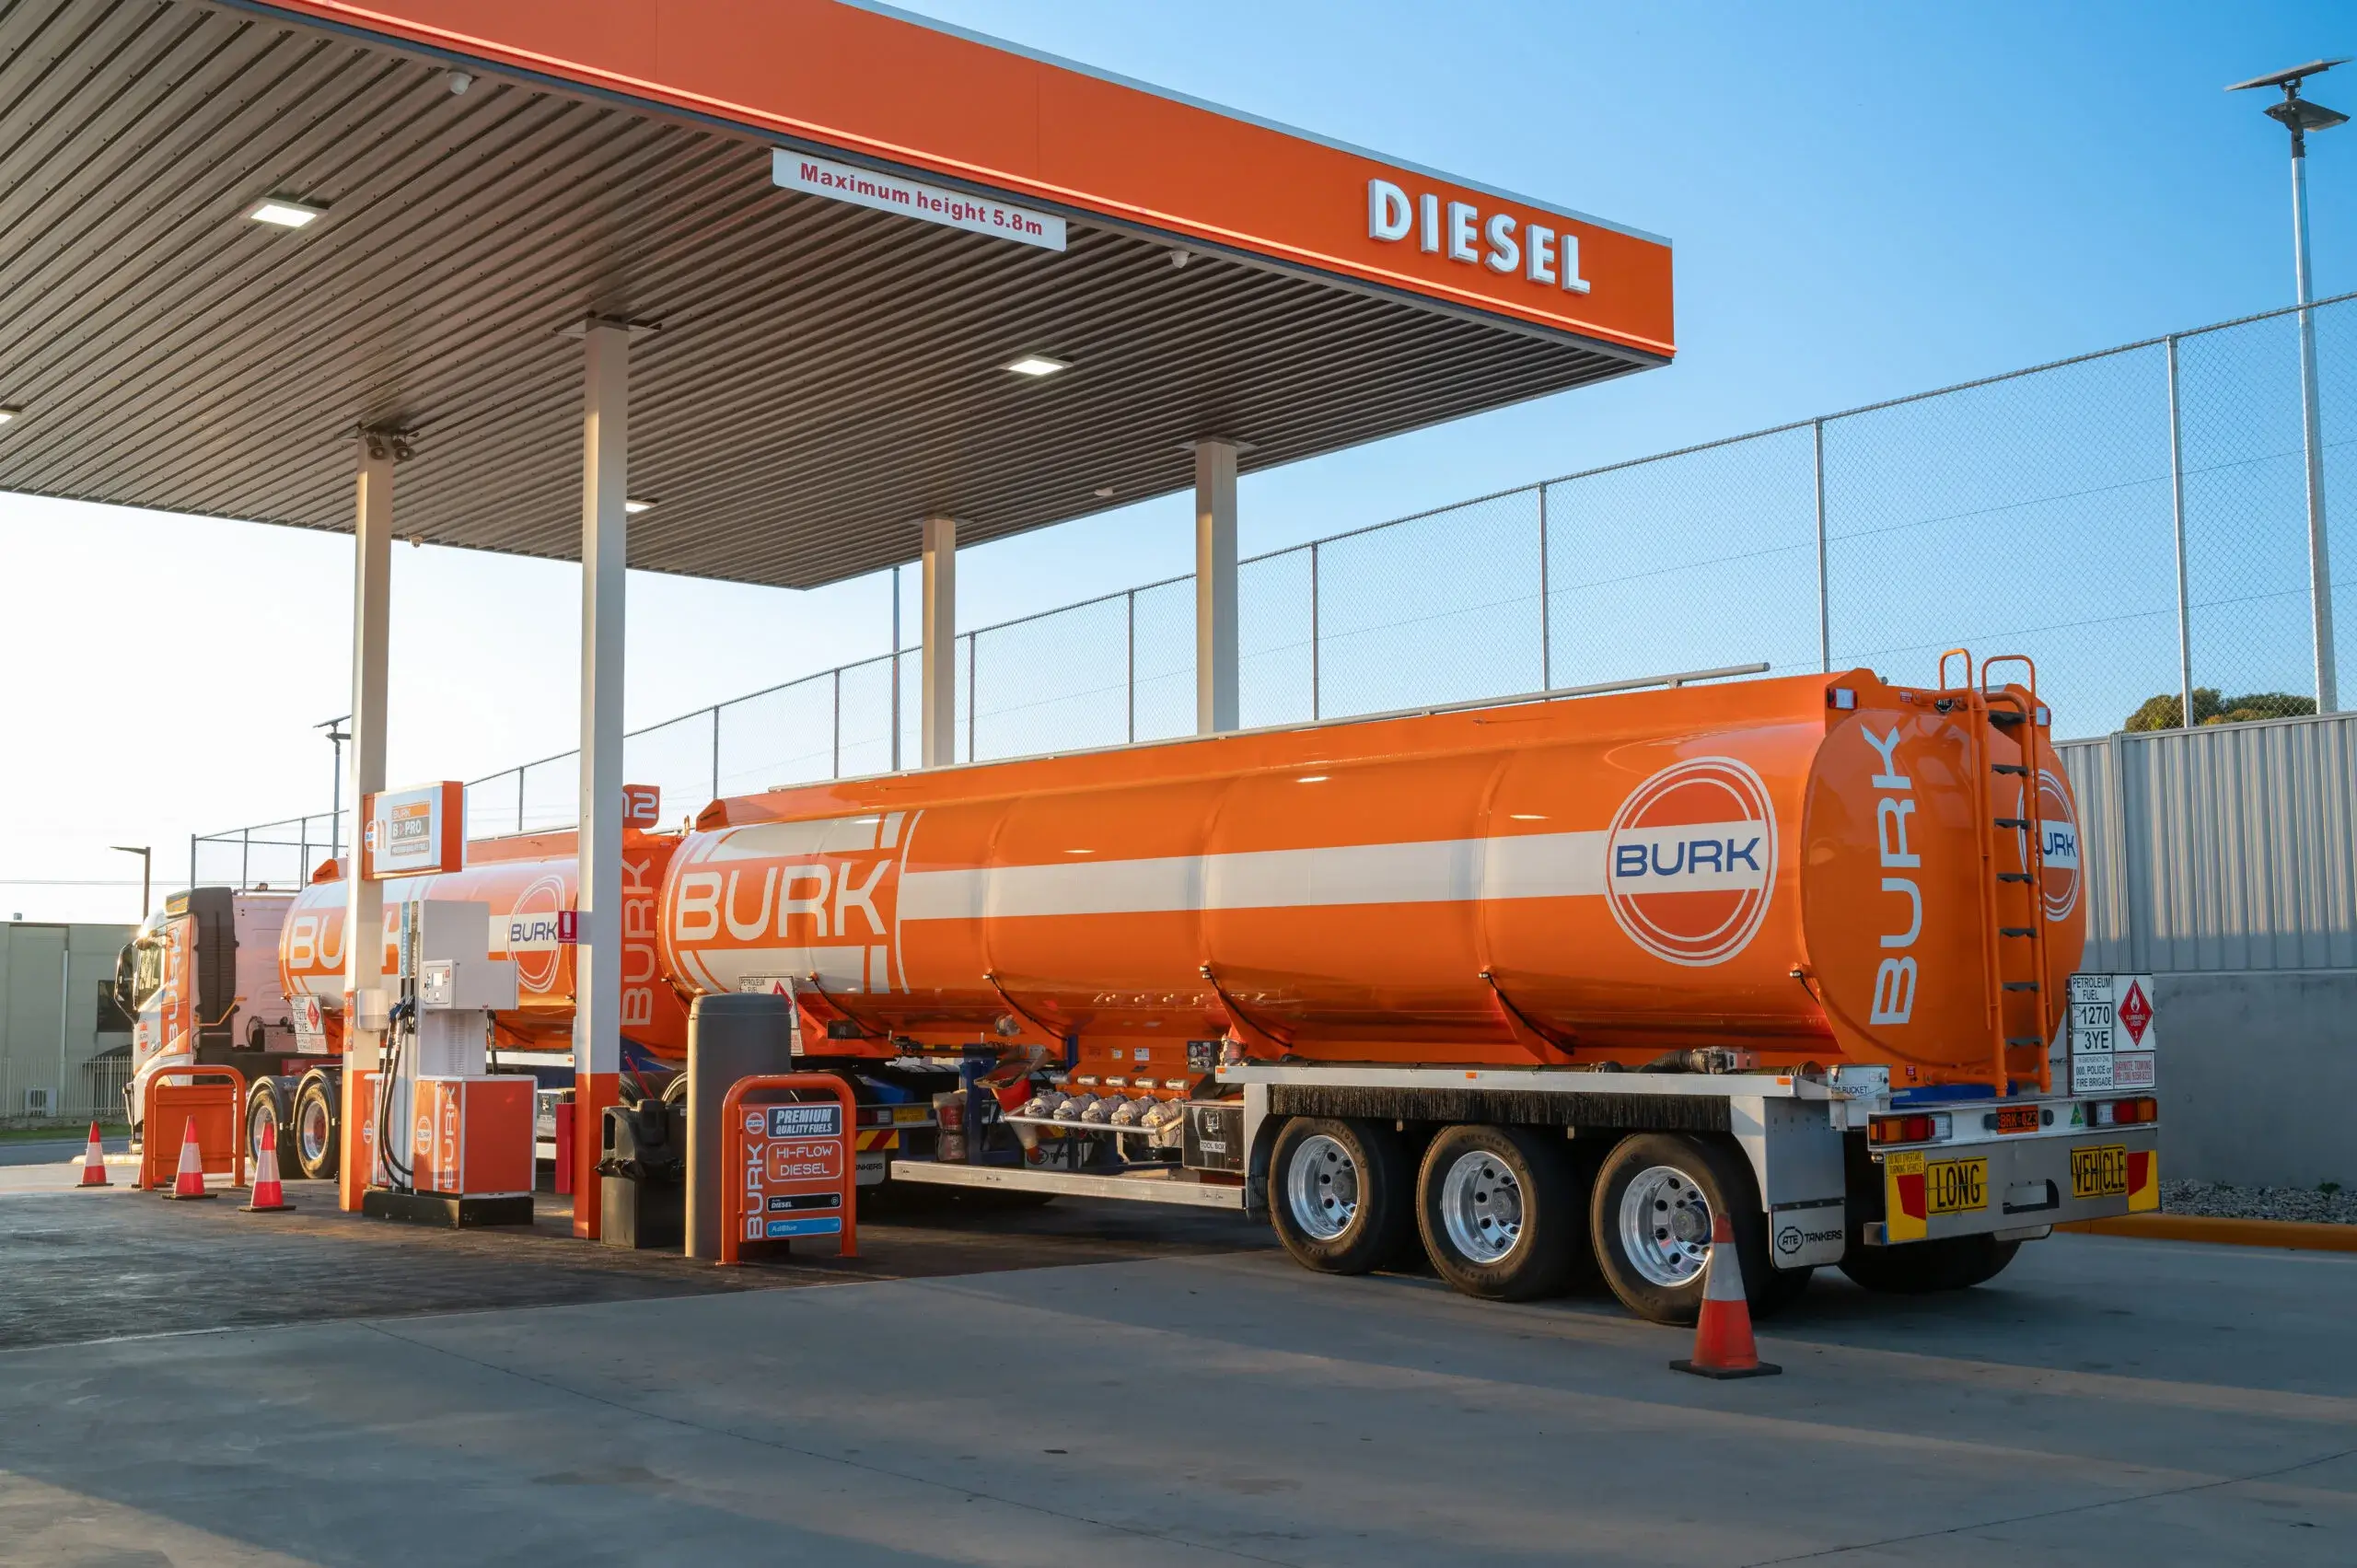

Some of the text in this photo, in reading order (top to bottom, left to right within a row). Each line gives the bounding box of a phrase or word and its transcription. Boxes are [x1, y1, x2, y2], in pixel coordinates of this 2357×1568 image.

[800, 162, 1042, 236] Maximum height 5.8m
[1368, 179, 1590, 295] DIESEL
[2038, 832, 2076, 857] URK
[1616, 837, 1761, 877] BURK
[1860, 722, 1922, 1025] BURK
[676, 859, 892, 941] BURK
[510, 922, 557, 942] BURK
[621, 857, 656, 1025] BURK
[2073, 978, 2110, 988] PETROLEUM
[2083, 990, 2099, 1000] FUEL
[2082, 1006, 2109, 1025] 1270
[2084, 1030, 2109, 1049] 3YE
[2087, 1064, 2106, 1074] POLICE
[1843, 1085, 1869, 1094] BUCKET
[2076, 1076, 2111, 1087] FIRE BRIGADE
[776, 1109, 832, 1124] PREMIUM
[444, 1086, 455, 1189] BURK
[776, 1122, 832, 1134] QUALITY FUELS
[776, 1144, 833, 1159] HI-FLOW
[780, 1163, 830, 1177] DIESEL
[2073, 1151, 2126, 1193] VEHICLE
[747, 1143, 763, 1238] BURK
[1936, 1164, 1980, 1208] LONG
[1805, 1229, 1843, 1243] TANKERS
